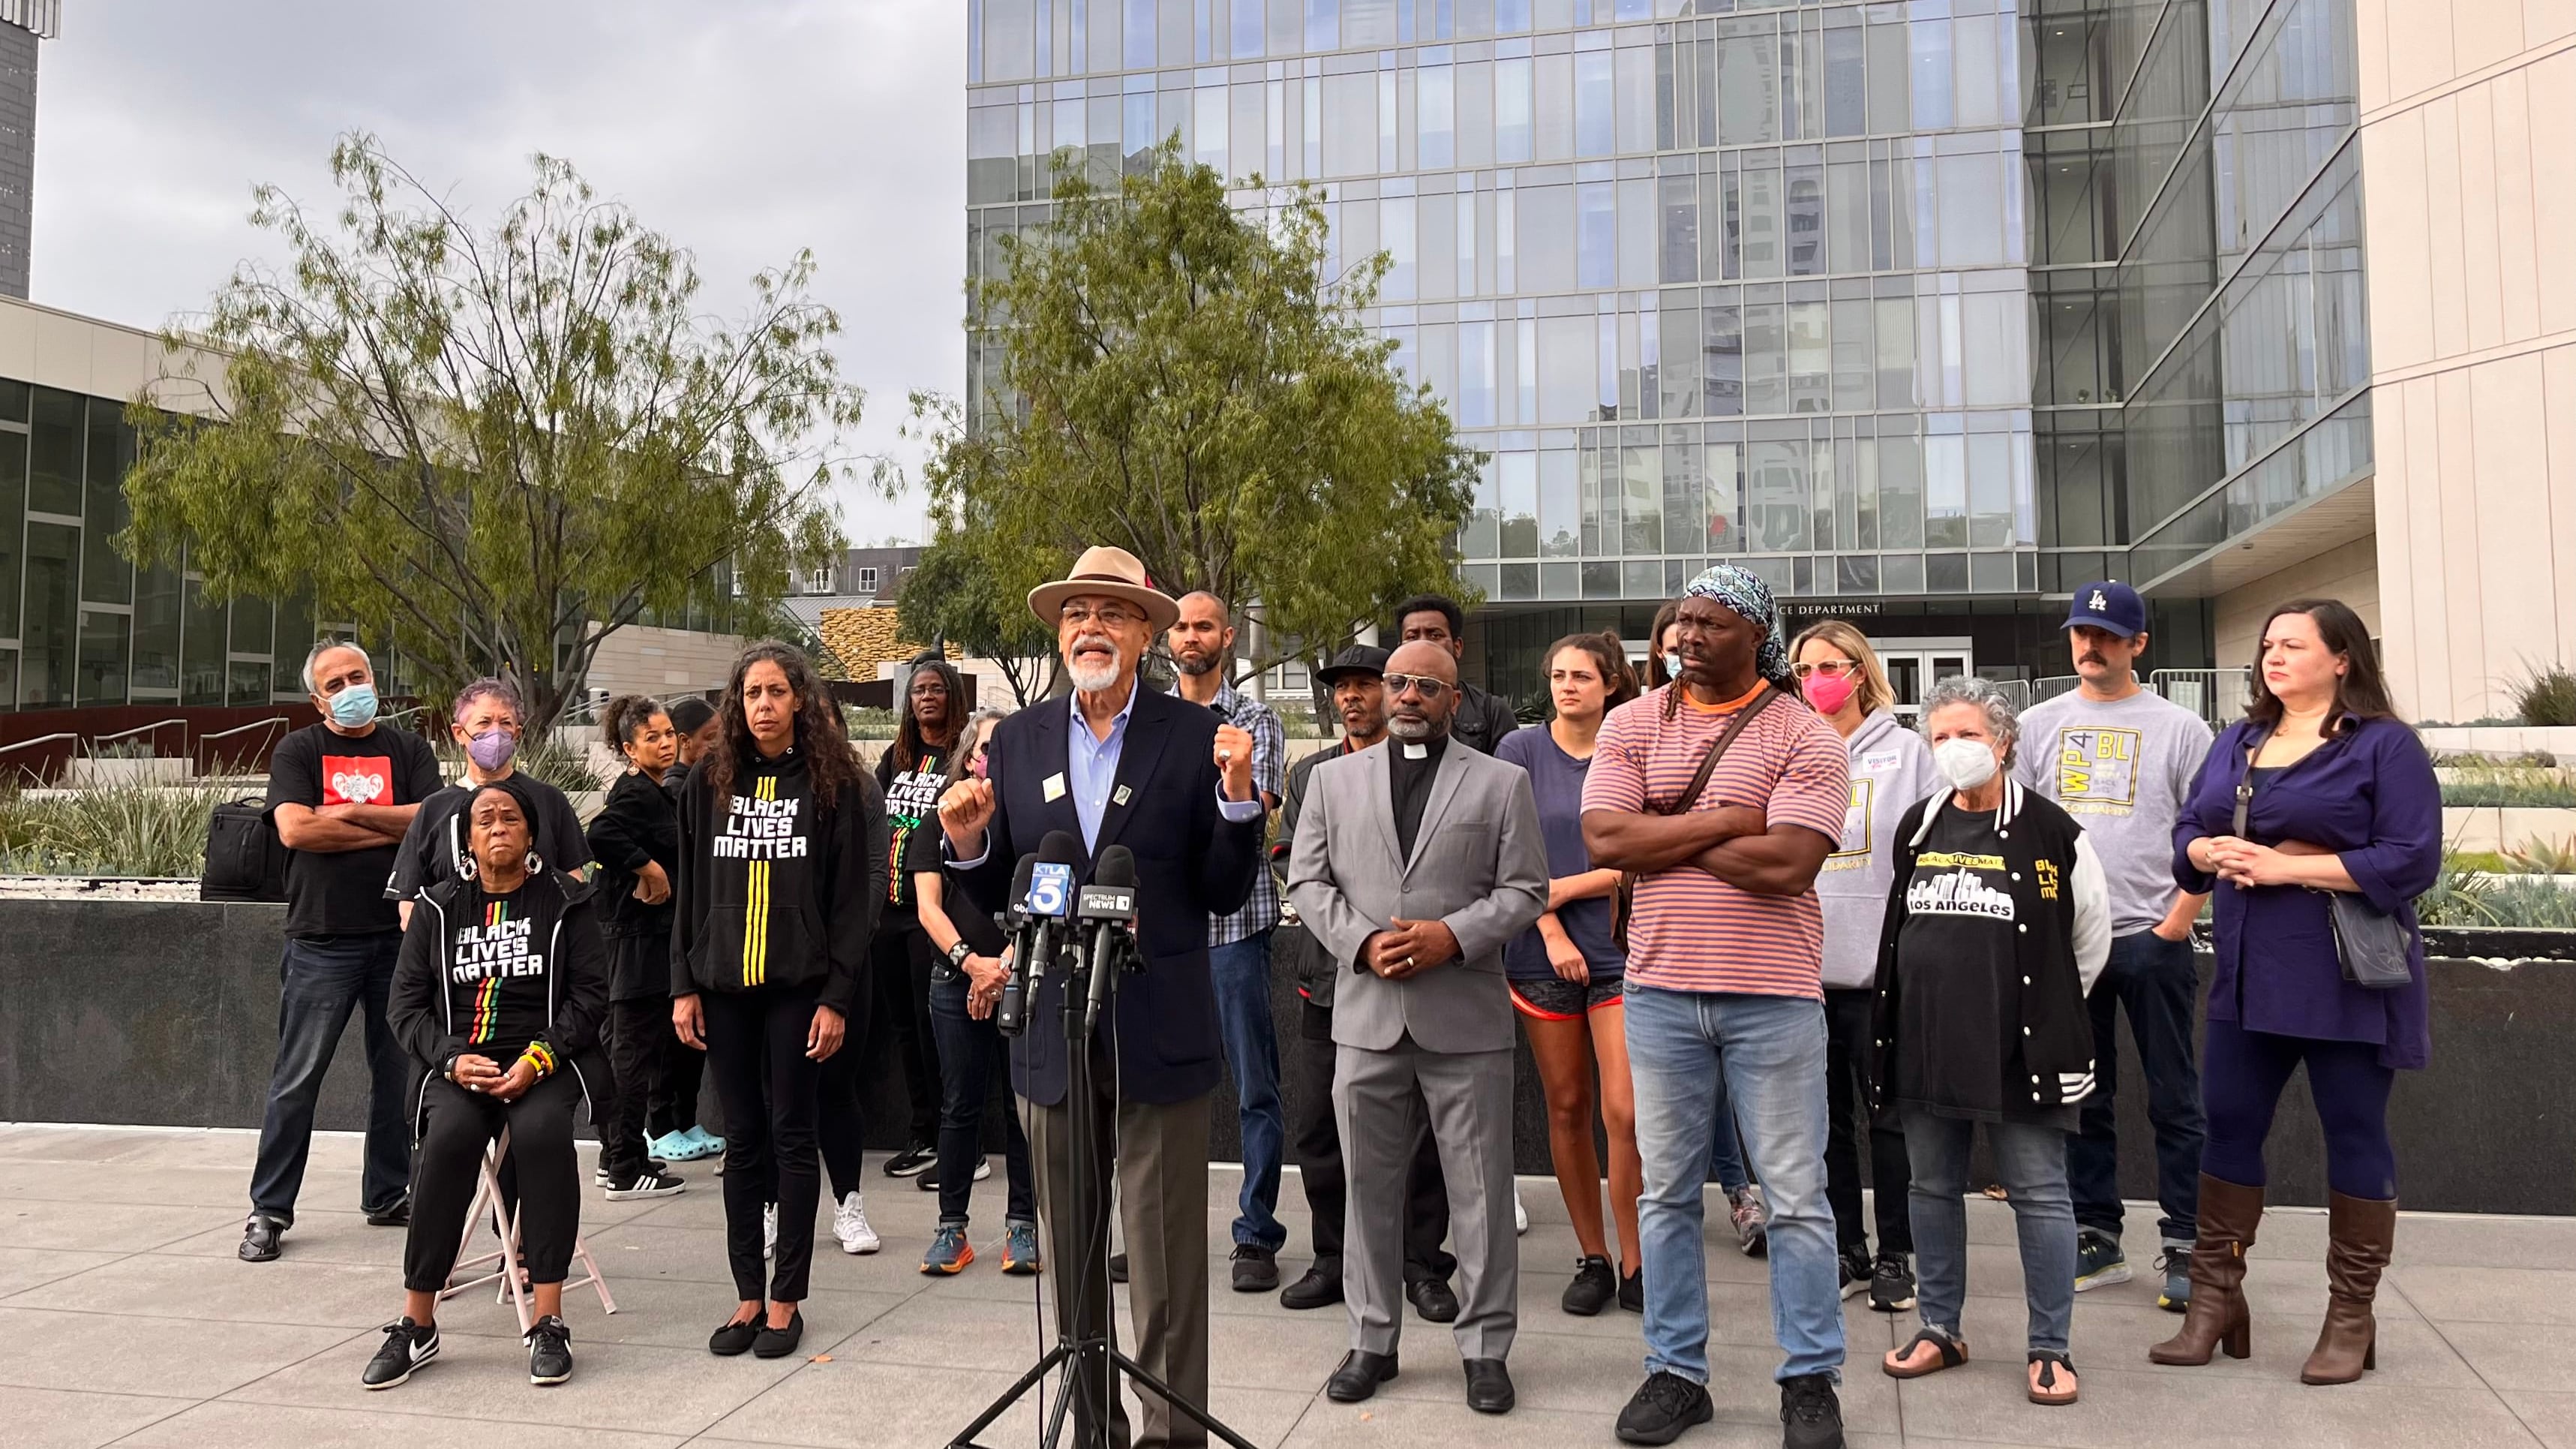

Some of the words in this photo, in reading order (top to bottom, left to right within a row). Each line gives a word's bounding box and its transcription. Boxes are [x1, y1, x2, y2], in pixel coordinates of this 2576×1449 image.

[1798, 604, 1880, 615] DEPARTMENT
[2088, 589, 2106, 611] LA
[2096, 732, 2130, 761] BL
[893, 770, 948, 788] BLACK
[887, 783, 937, 803] LIVES
[728, 795, 800, 818] BLACK
[2064, 802, 2133, 818] SOLIDARITY
[726, 815, 793, 838] LIVES
[713, 835, 807, 859] MATTER
[1034, 864, 1067, 876] KTLA
[1032, 877, 1063, 913] 5
[1082, 894, 1115, 902] SPECTRUM
[1088, 900, 1115, 910] NEWS
[455, 917, 532, 945] BLACK
[455, 936, 528, 965] LIVES
[452, 954, 543, 984] MATTER
